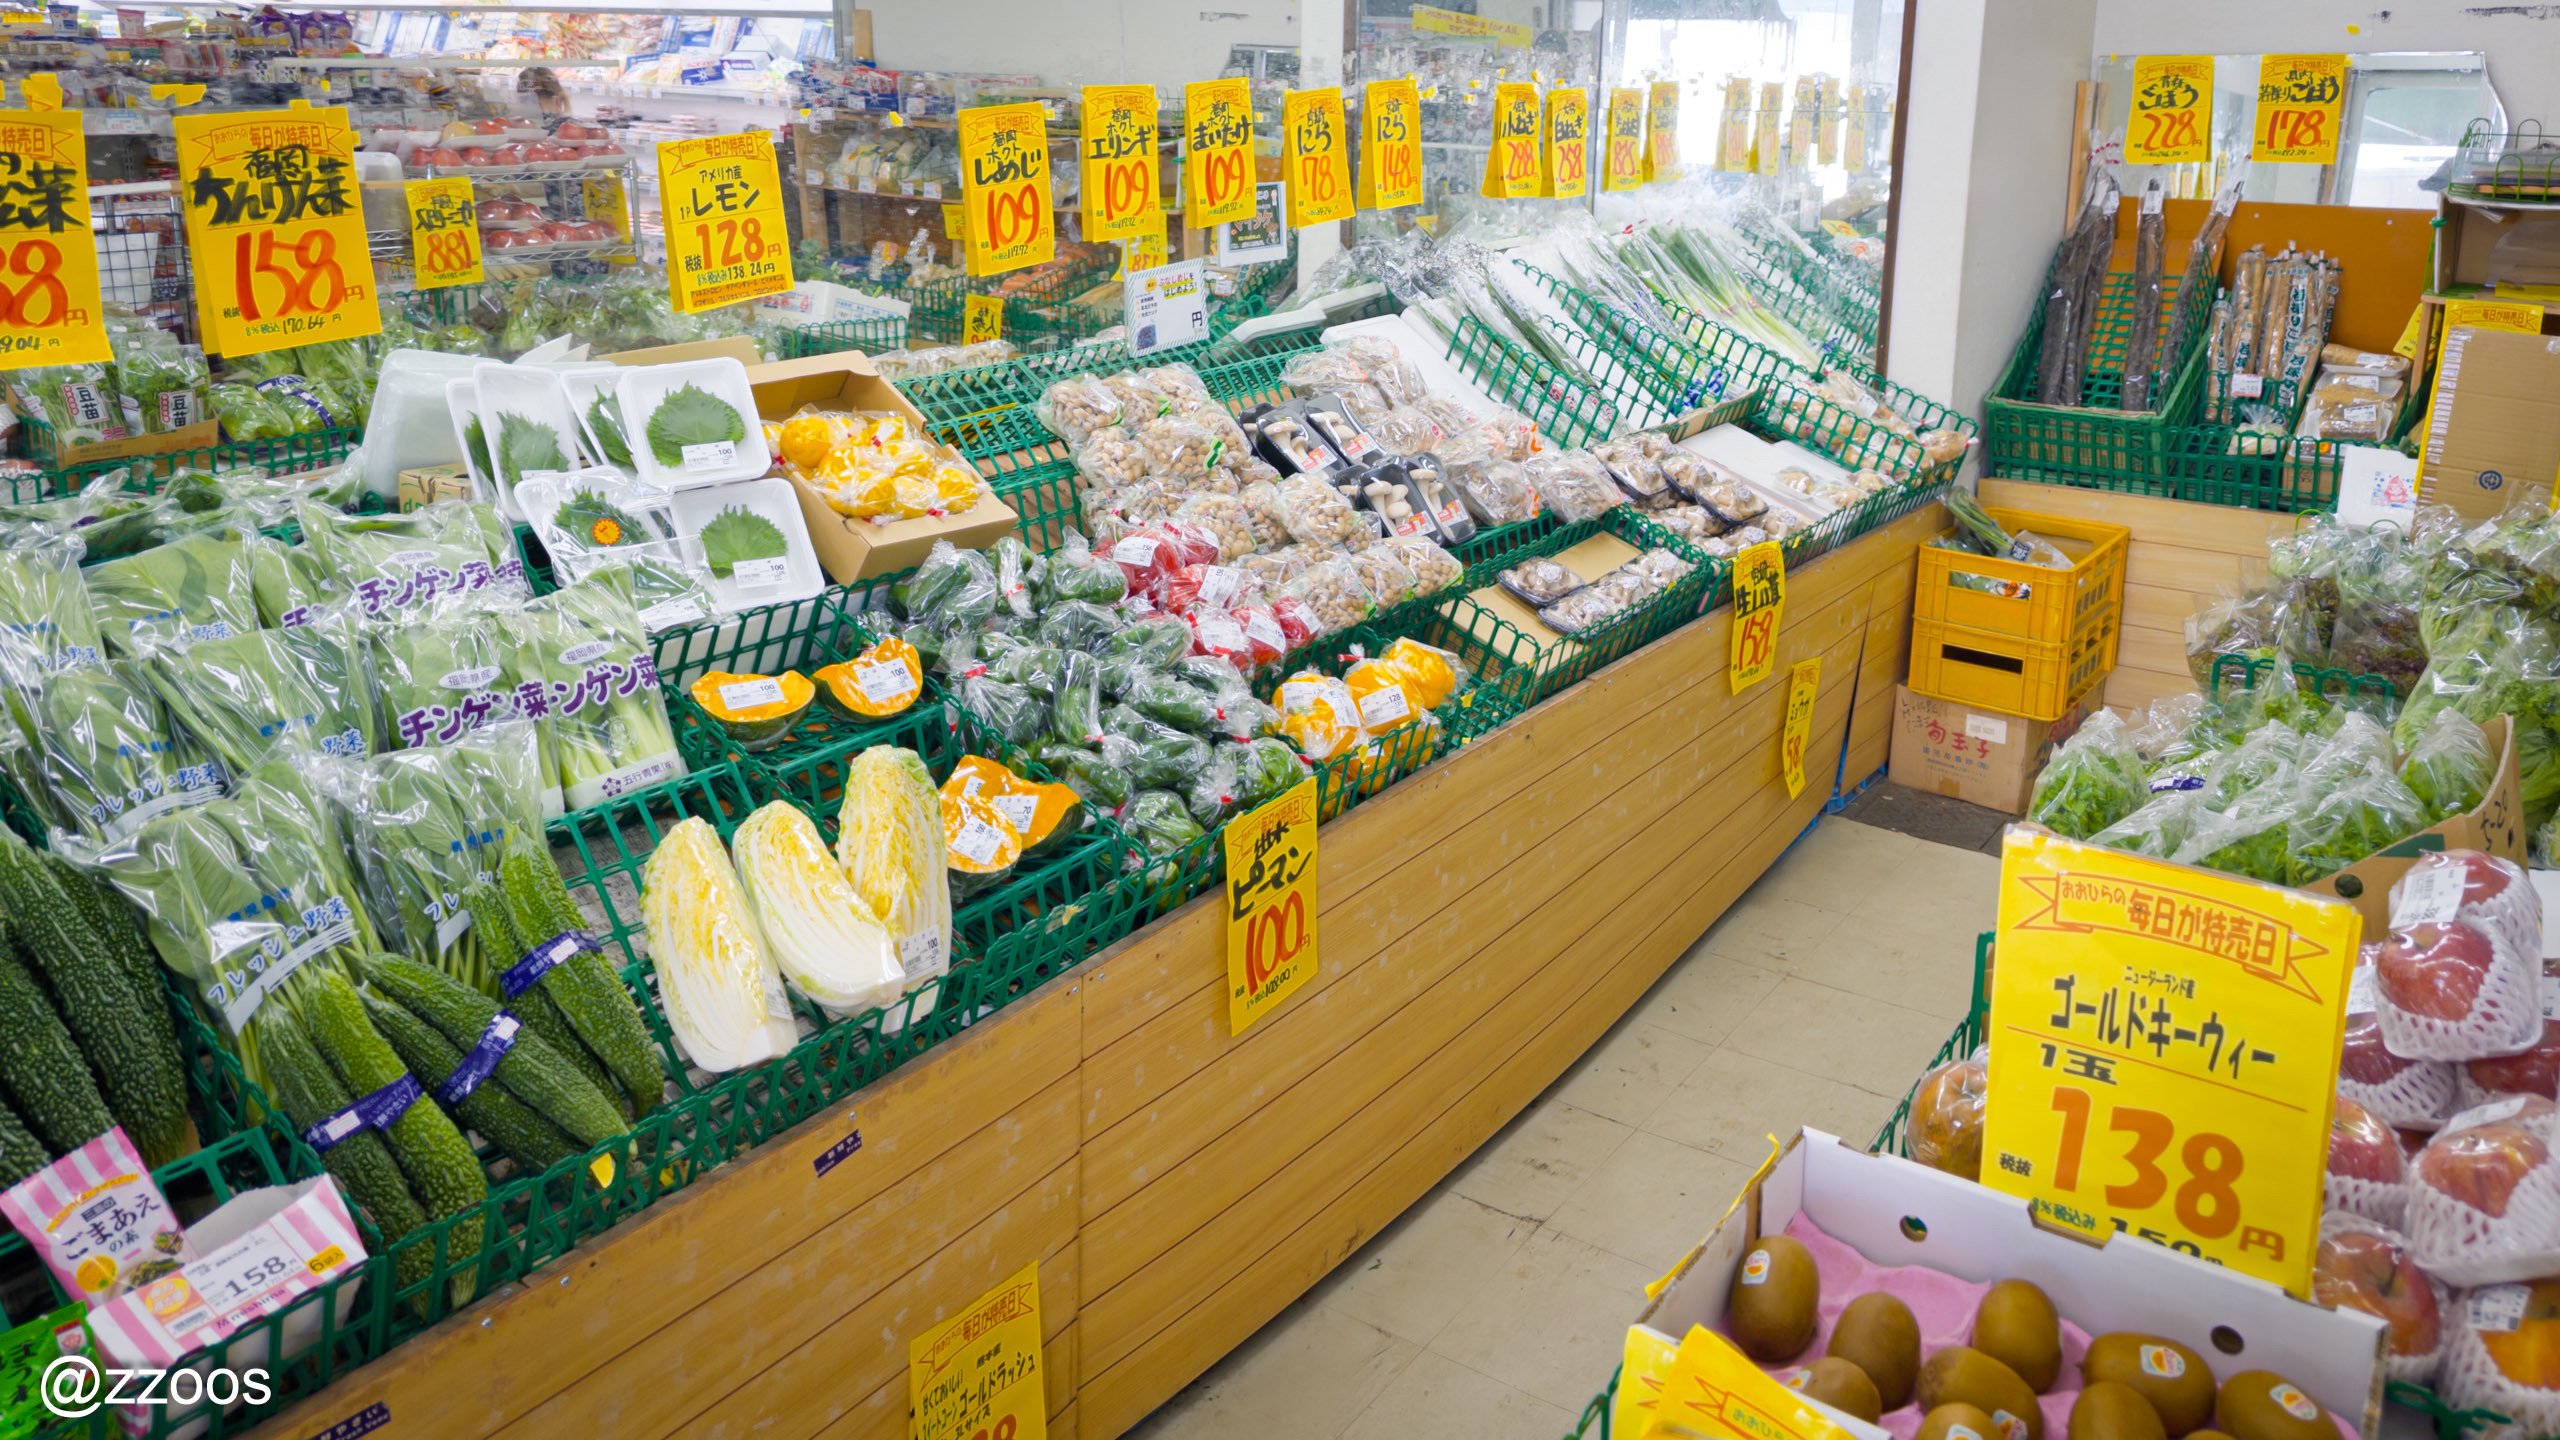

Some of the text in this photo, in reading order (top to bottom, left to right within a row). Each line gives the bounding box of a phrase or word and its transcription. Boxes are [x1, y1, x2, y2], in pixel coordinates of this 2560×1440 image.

[249, 124, 323, 150] 毎日が特売日
[1089, 123, 1156, 160] エリンギ
[1191, 114, 1252, 152] まいたけ
[1297, 118, 1332, 156] にら
[1376, 112, 1407, 142] にら
[704, 136, 756, 158] 毎日が特売日
[698, 164, 743, 184] アメリカ産
[974, 148, 1043, 186] しめじ
[690, 180, 761, 216] レモン
[1191, 310, 1203, 329] 円
[75, 386, 101, 422] 豆苗
[171, 394, 189, 429] 豆苗
[550, 653, 660, 714] ンゲン菜
[400, 681, 551, 748] チンゲン菜
[1232, 845, 1314, 923] ピーマン
[2127, 888, 2279, 968] 毎日が特売日
[205, 895, 351, 1005] フレッシュ野菜
[2049, 973, 2277, 1081] ゴールドキーウィー
[2040, 1042, 2119, 1087] 1玉
[1999, 1152, 2034, 1178] 税抜
[61, 1192, 161, 1261] ごまあえ
[108, 1228, 141, 1254] の素
[962, 1289, 1016, 1342] 毎日が特売日
[958, 1350, 1036, 1420] ゴールドラッシュ
